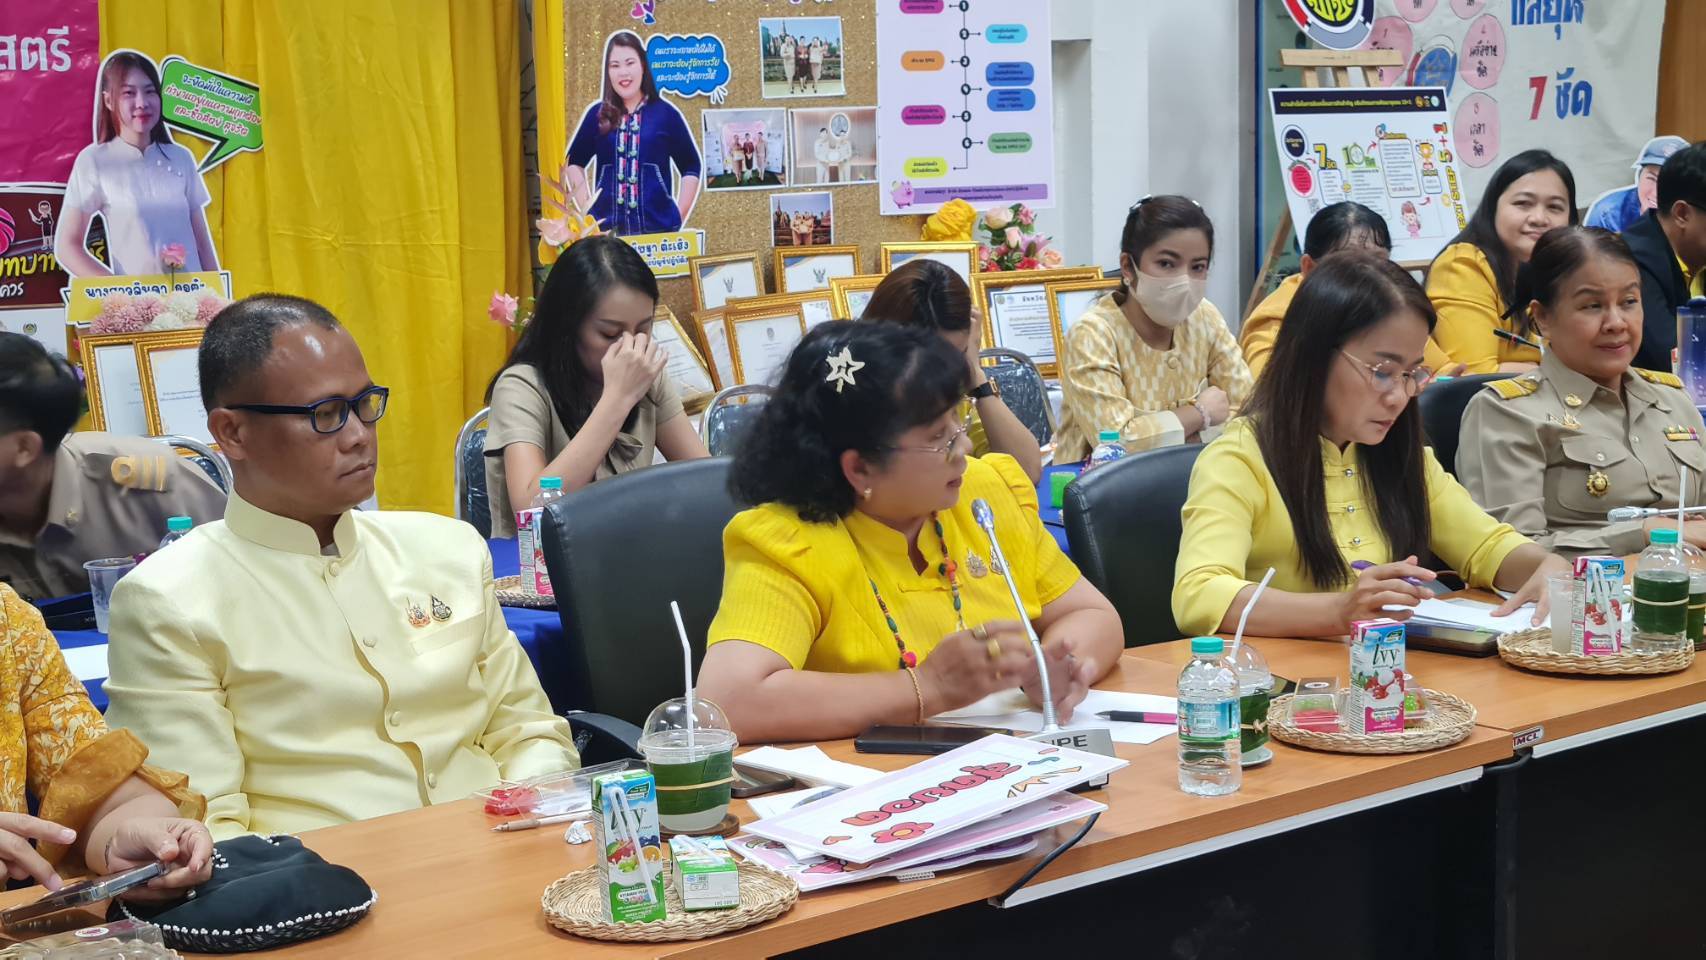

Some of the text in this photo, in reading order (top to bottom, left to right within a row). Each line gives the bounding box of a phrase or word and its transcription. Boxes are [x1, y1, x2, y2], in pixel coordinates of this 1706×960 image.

[1528, 67, 1593, 120] 7 ชัด
[1372, 642, 1401, 669] Ivy
[840, 762, 1022, 827] สุดยอด
